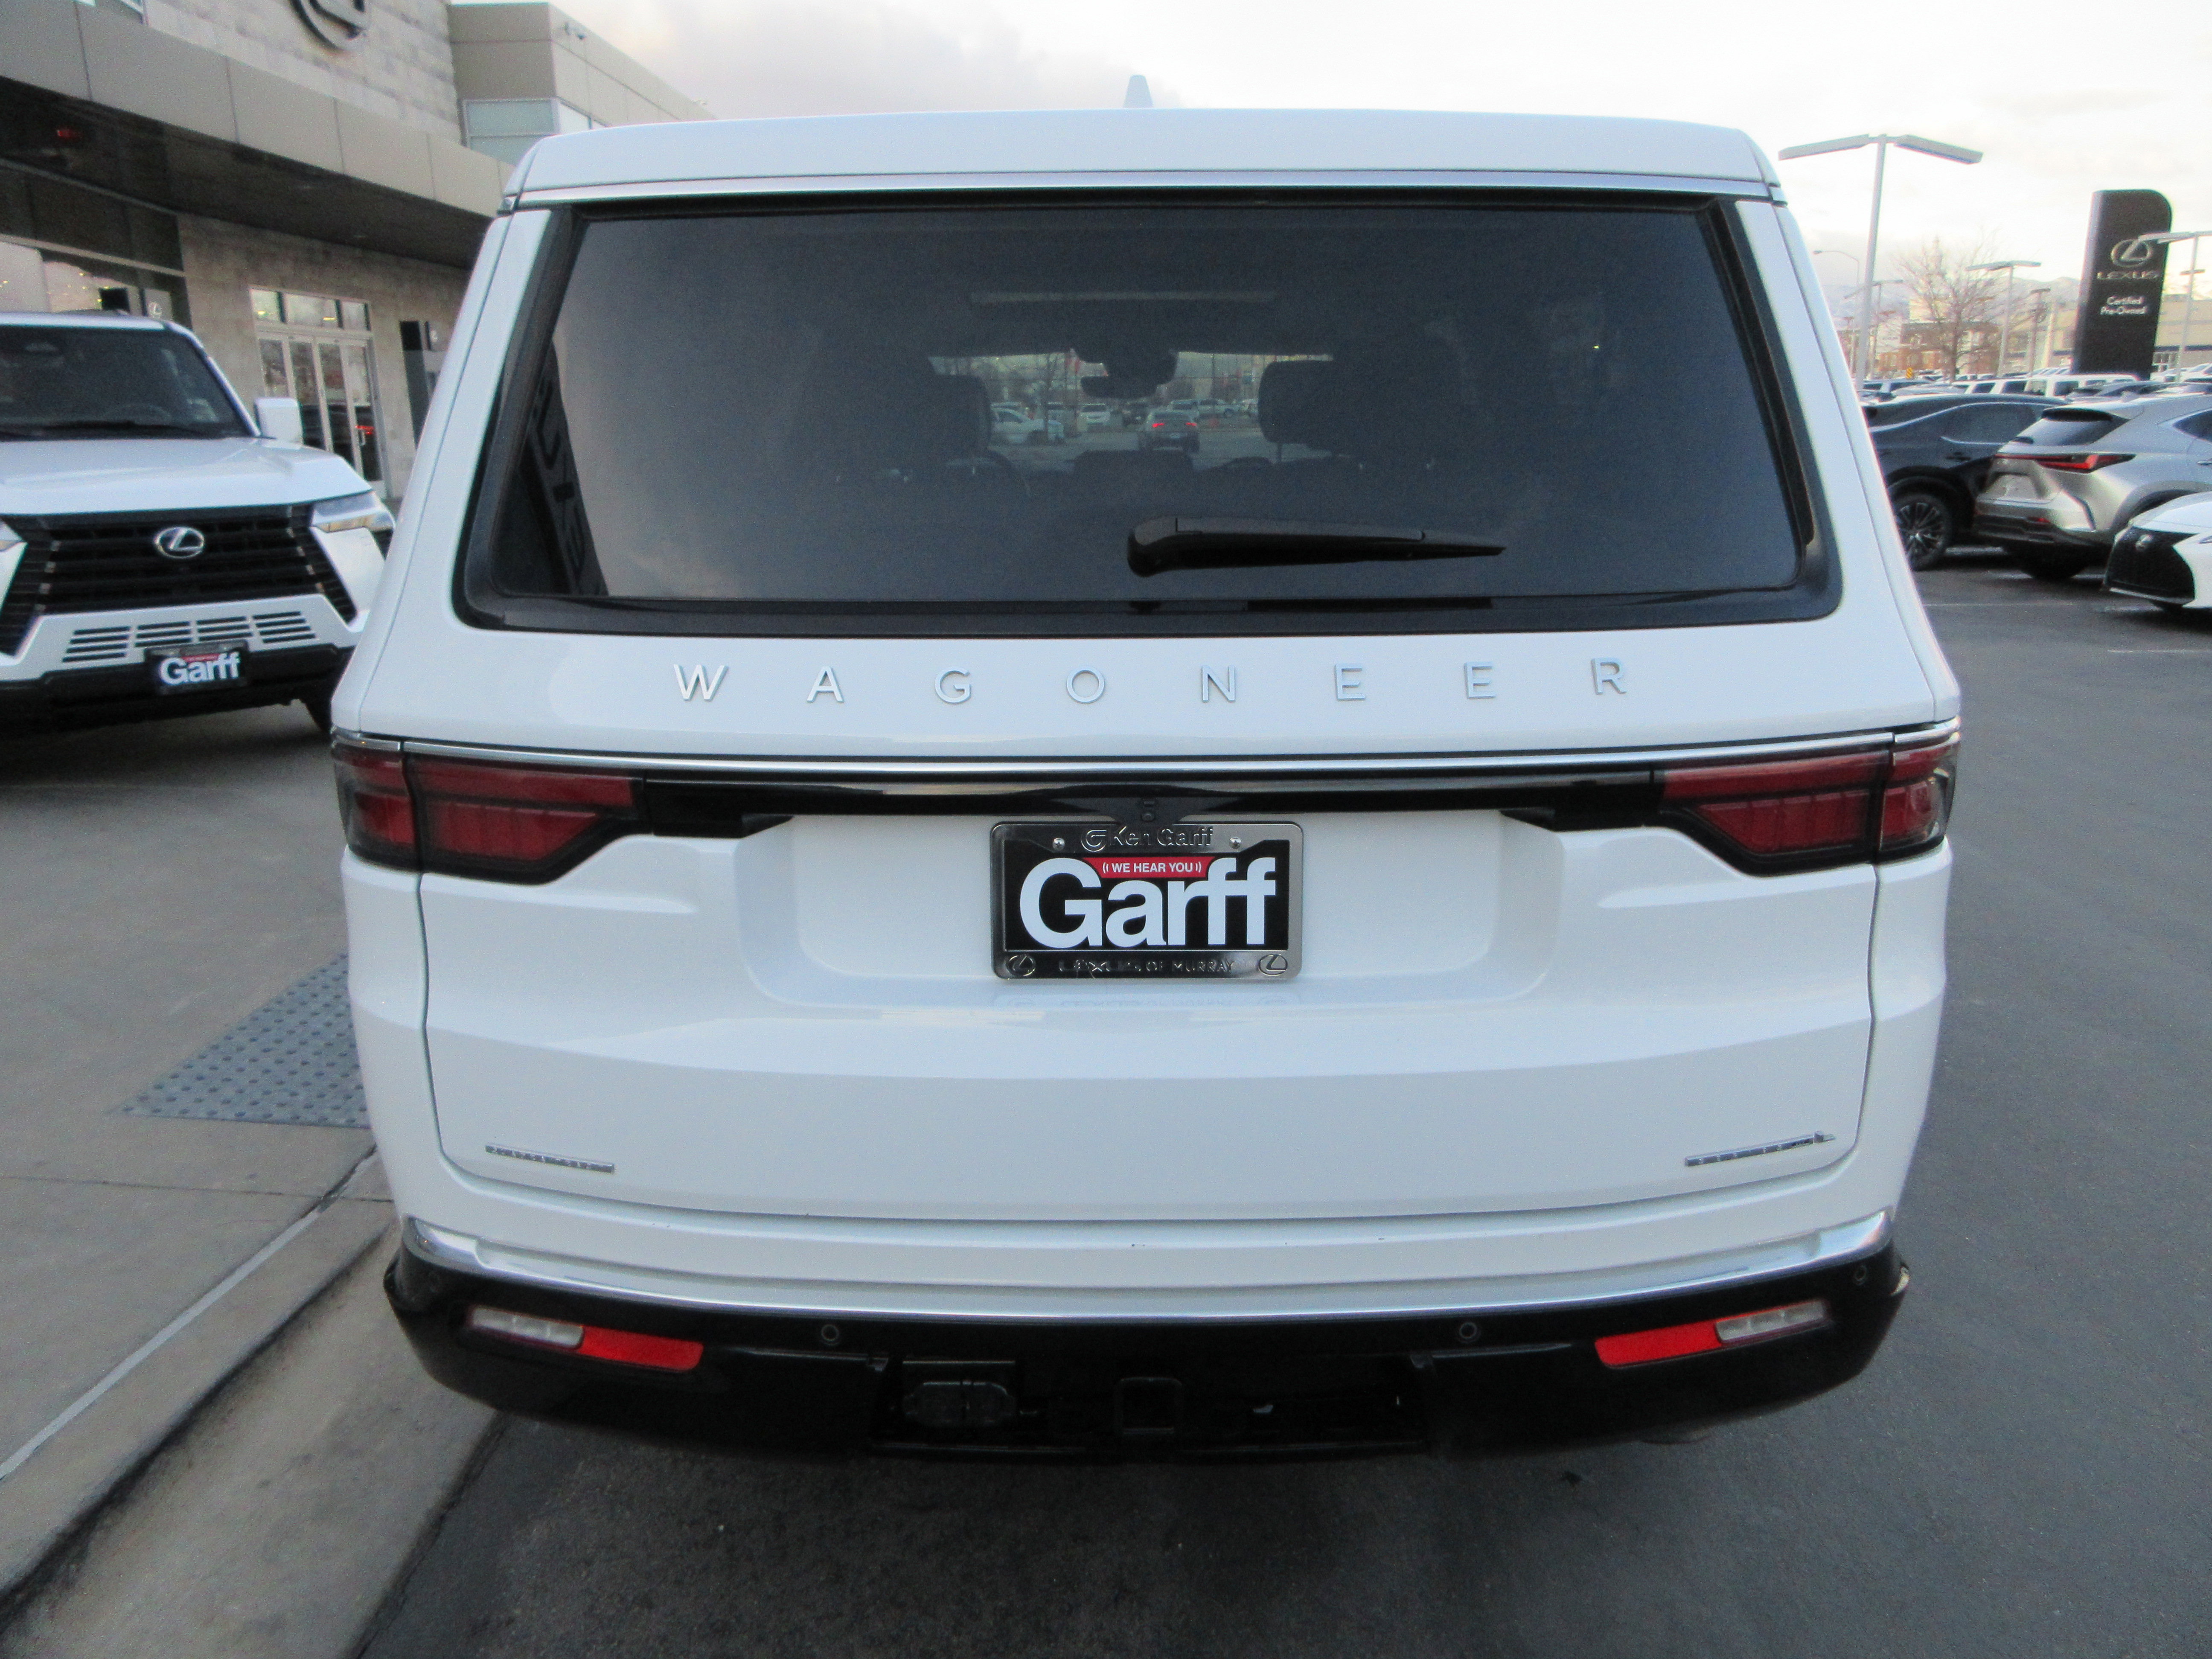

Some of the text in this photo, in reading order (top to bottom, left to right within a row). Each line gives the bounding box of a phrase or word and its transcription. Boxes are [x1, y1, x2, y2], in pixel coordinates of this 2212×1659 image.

[160, 652, 241, 686] Garff
[673, 657, 1627, 704] WAGONEER
[1110, 826, 1214, 846] Ken Garff
[1112, 862, 1193, 873] WE HEAR YOU
[1019, 857, 1276, 949] Garff
[1172, 960, 1235, 972] MURRAY
